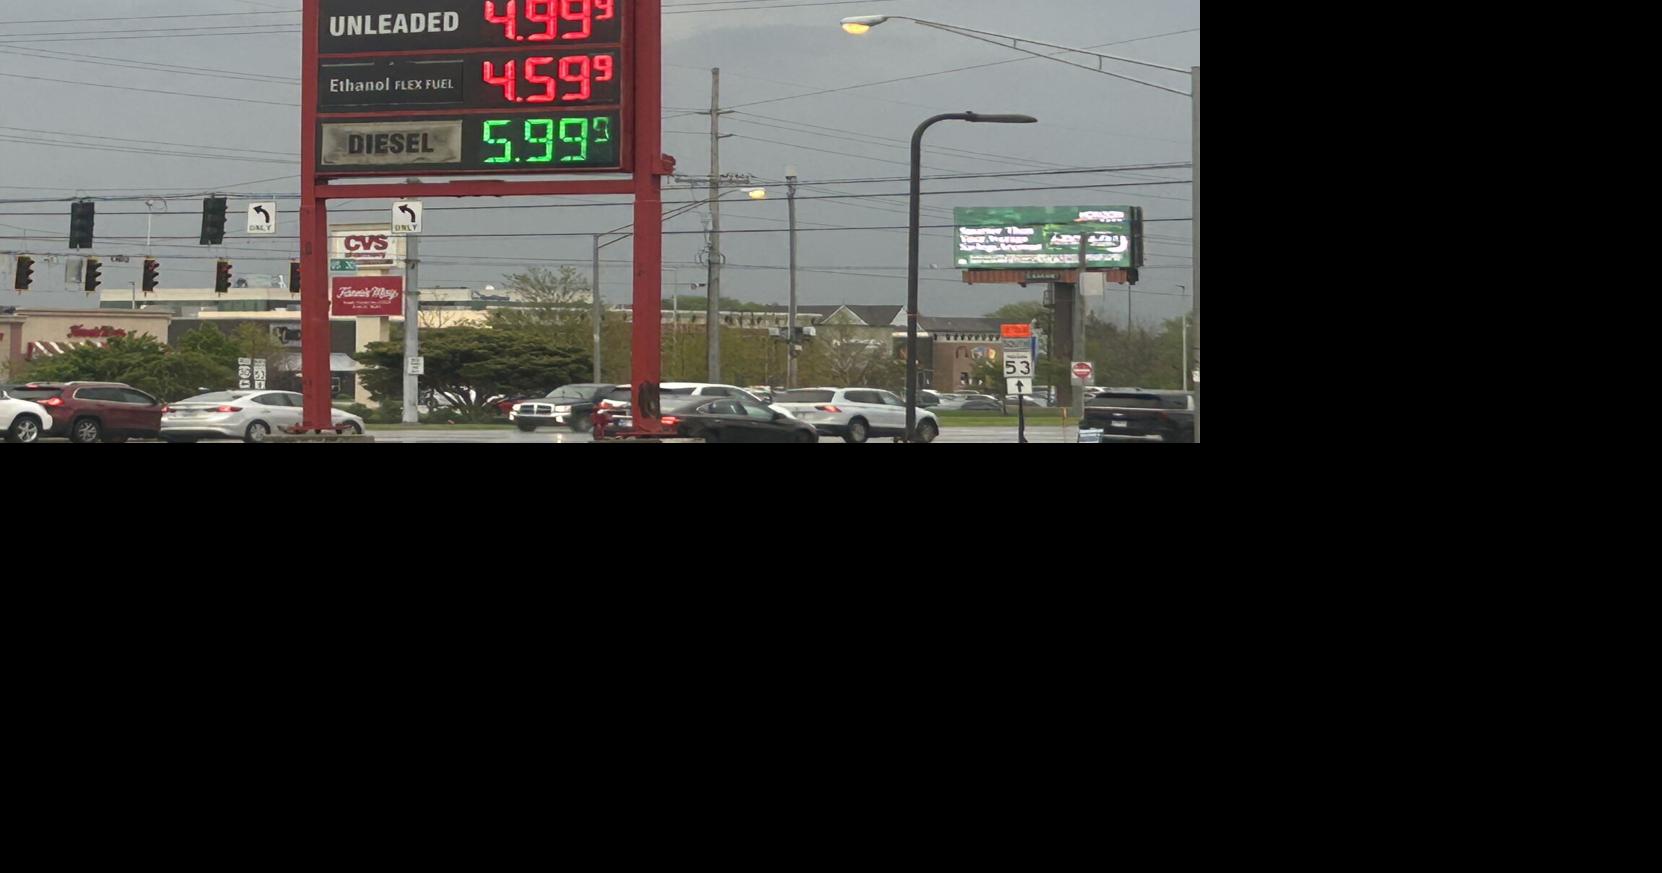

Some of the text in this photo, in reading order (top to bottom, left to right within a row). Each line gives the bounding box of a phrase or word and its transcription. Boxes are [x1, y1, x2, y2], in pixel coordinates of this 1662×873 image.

[330, 11, 459, 36] UNLEADED
[330, 77, 453, 92] Ethanol FLEX FUEL
[348, 133, 434, 154] DIESEL
[344, 234, 388, 251] CVS
[1005, 360, 1030, 375] 53
